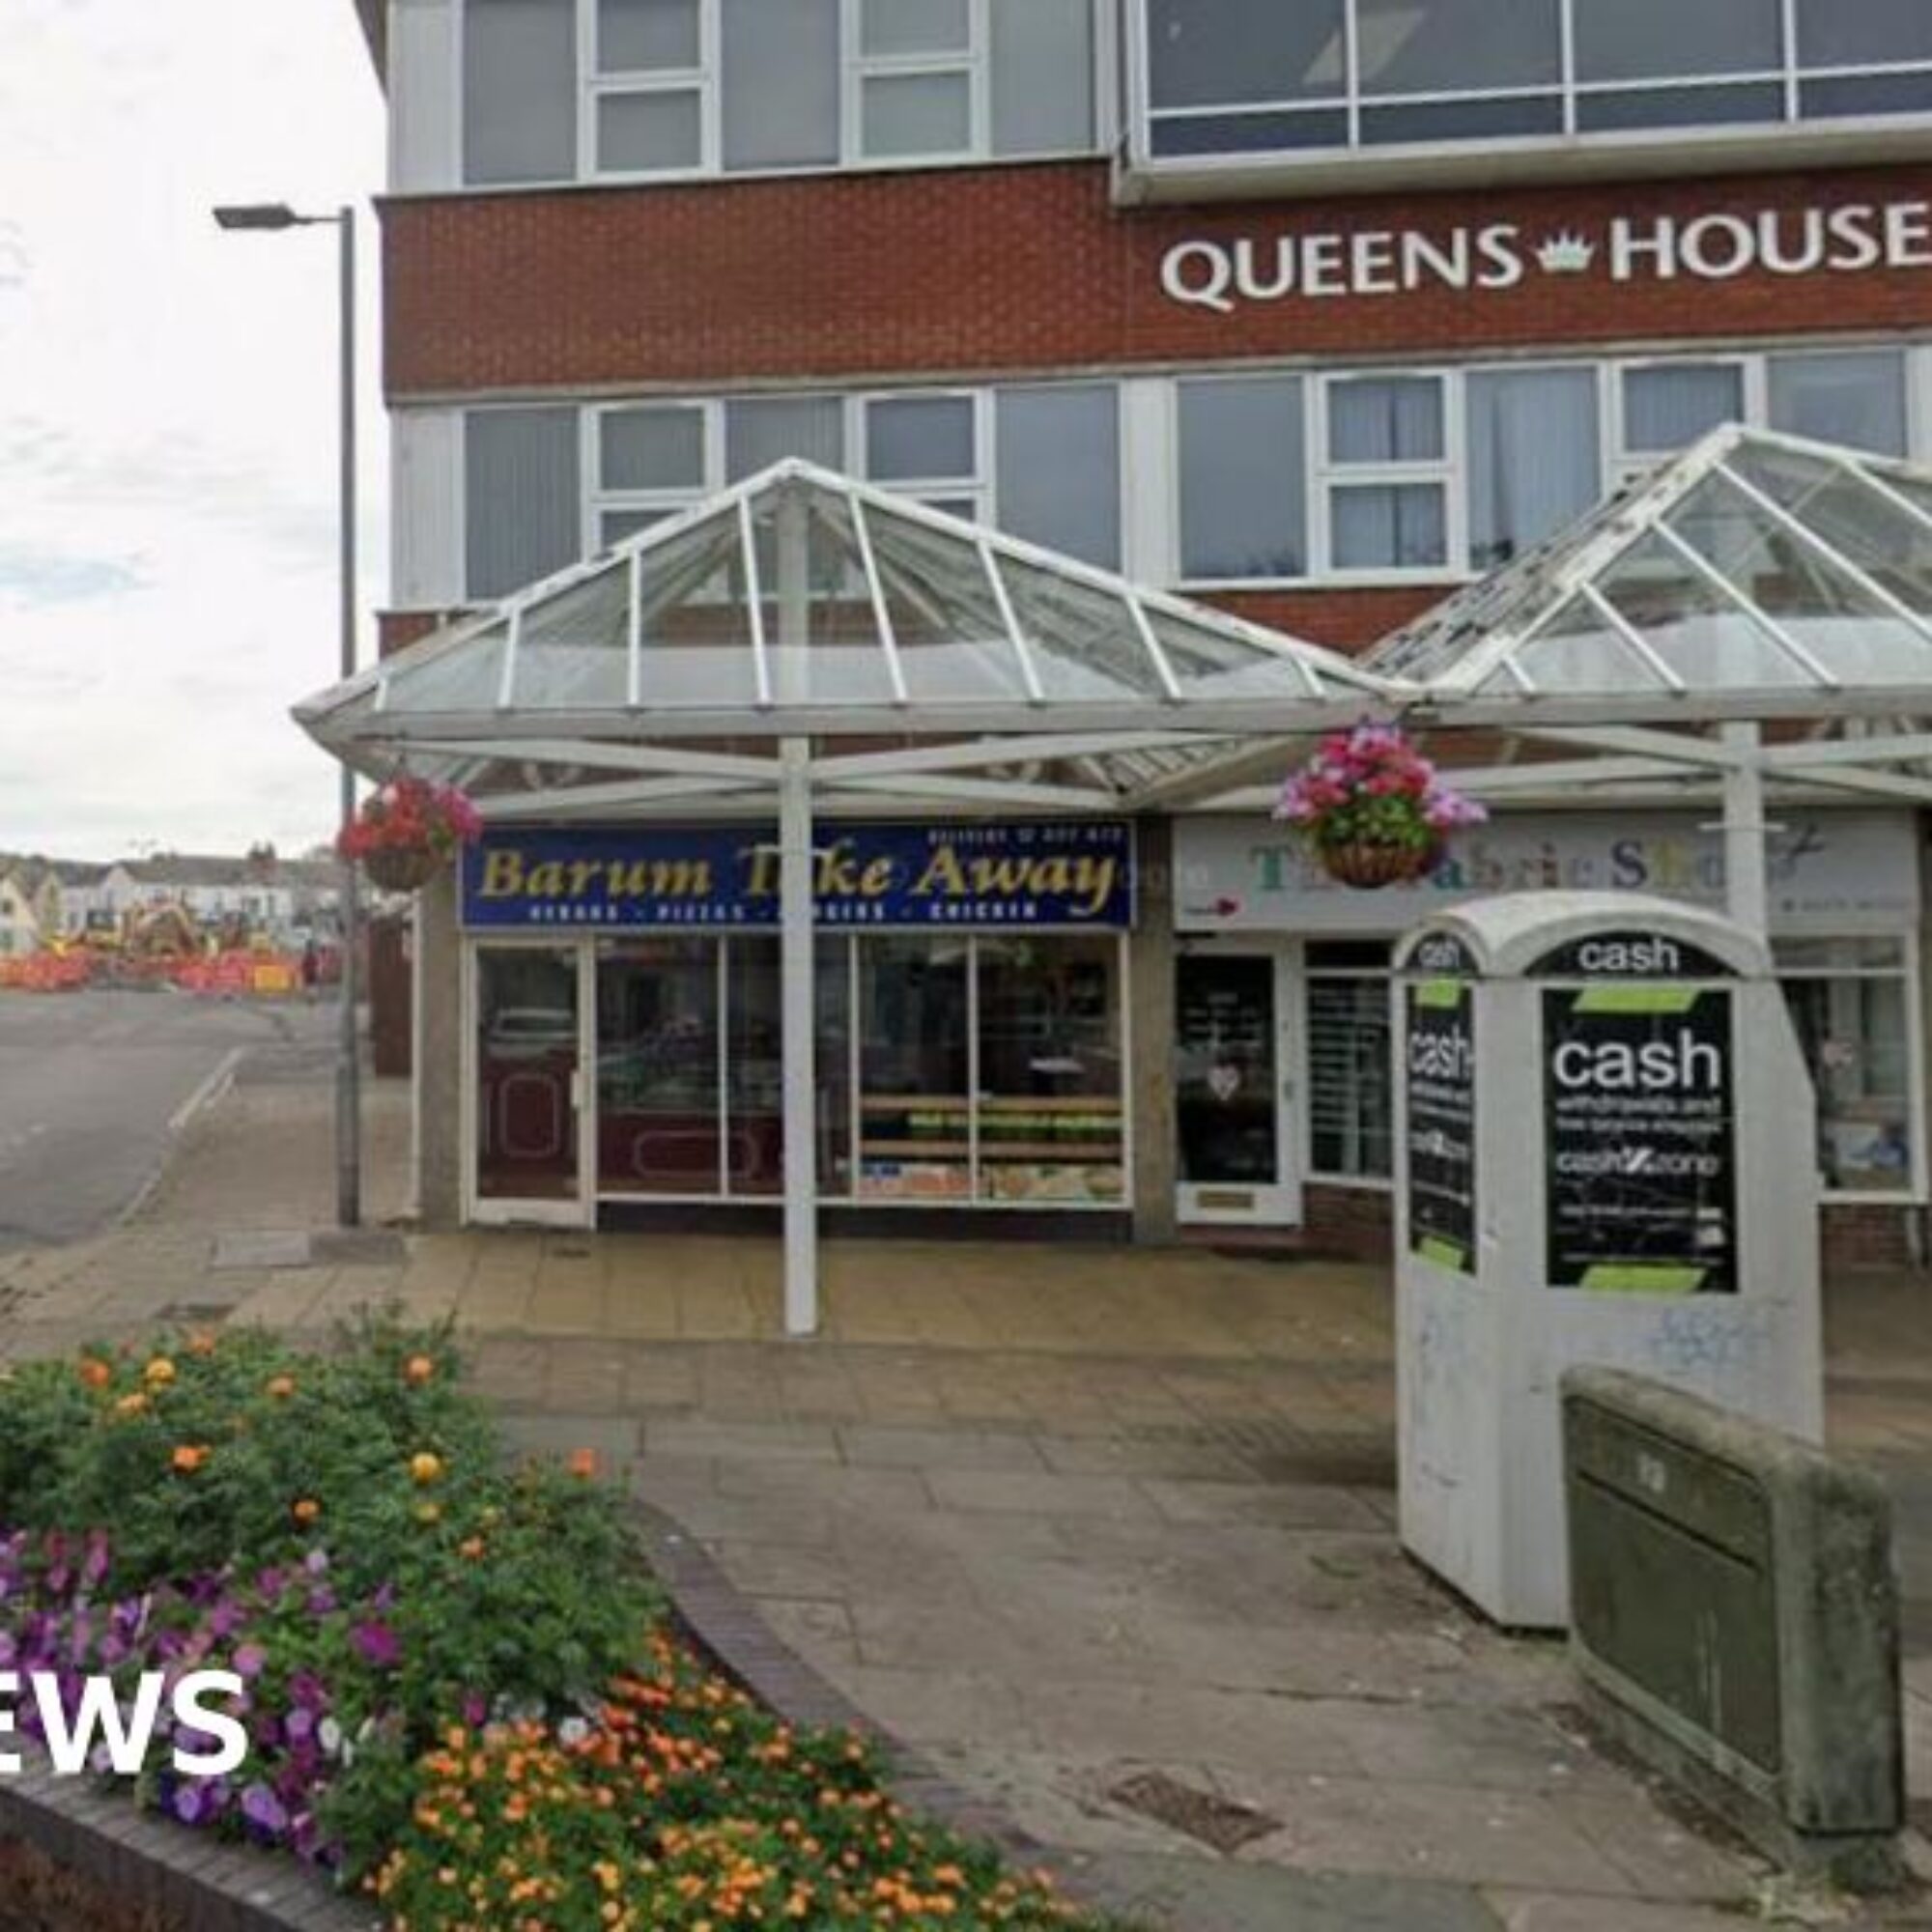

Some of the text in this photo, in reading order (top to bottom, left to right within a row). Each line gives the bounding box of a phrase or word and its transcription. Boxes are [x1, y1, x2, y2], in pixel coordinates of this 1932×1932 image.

[1161, 202, 1932, 313] QUEENS HOUSE
[479, 836, 1118, 917] Barum Tke Away
[1578, 937, 1680, 971] cash
[1553, 1028, 1722, 1089] cash
